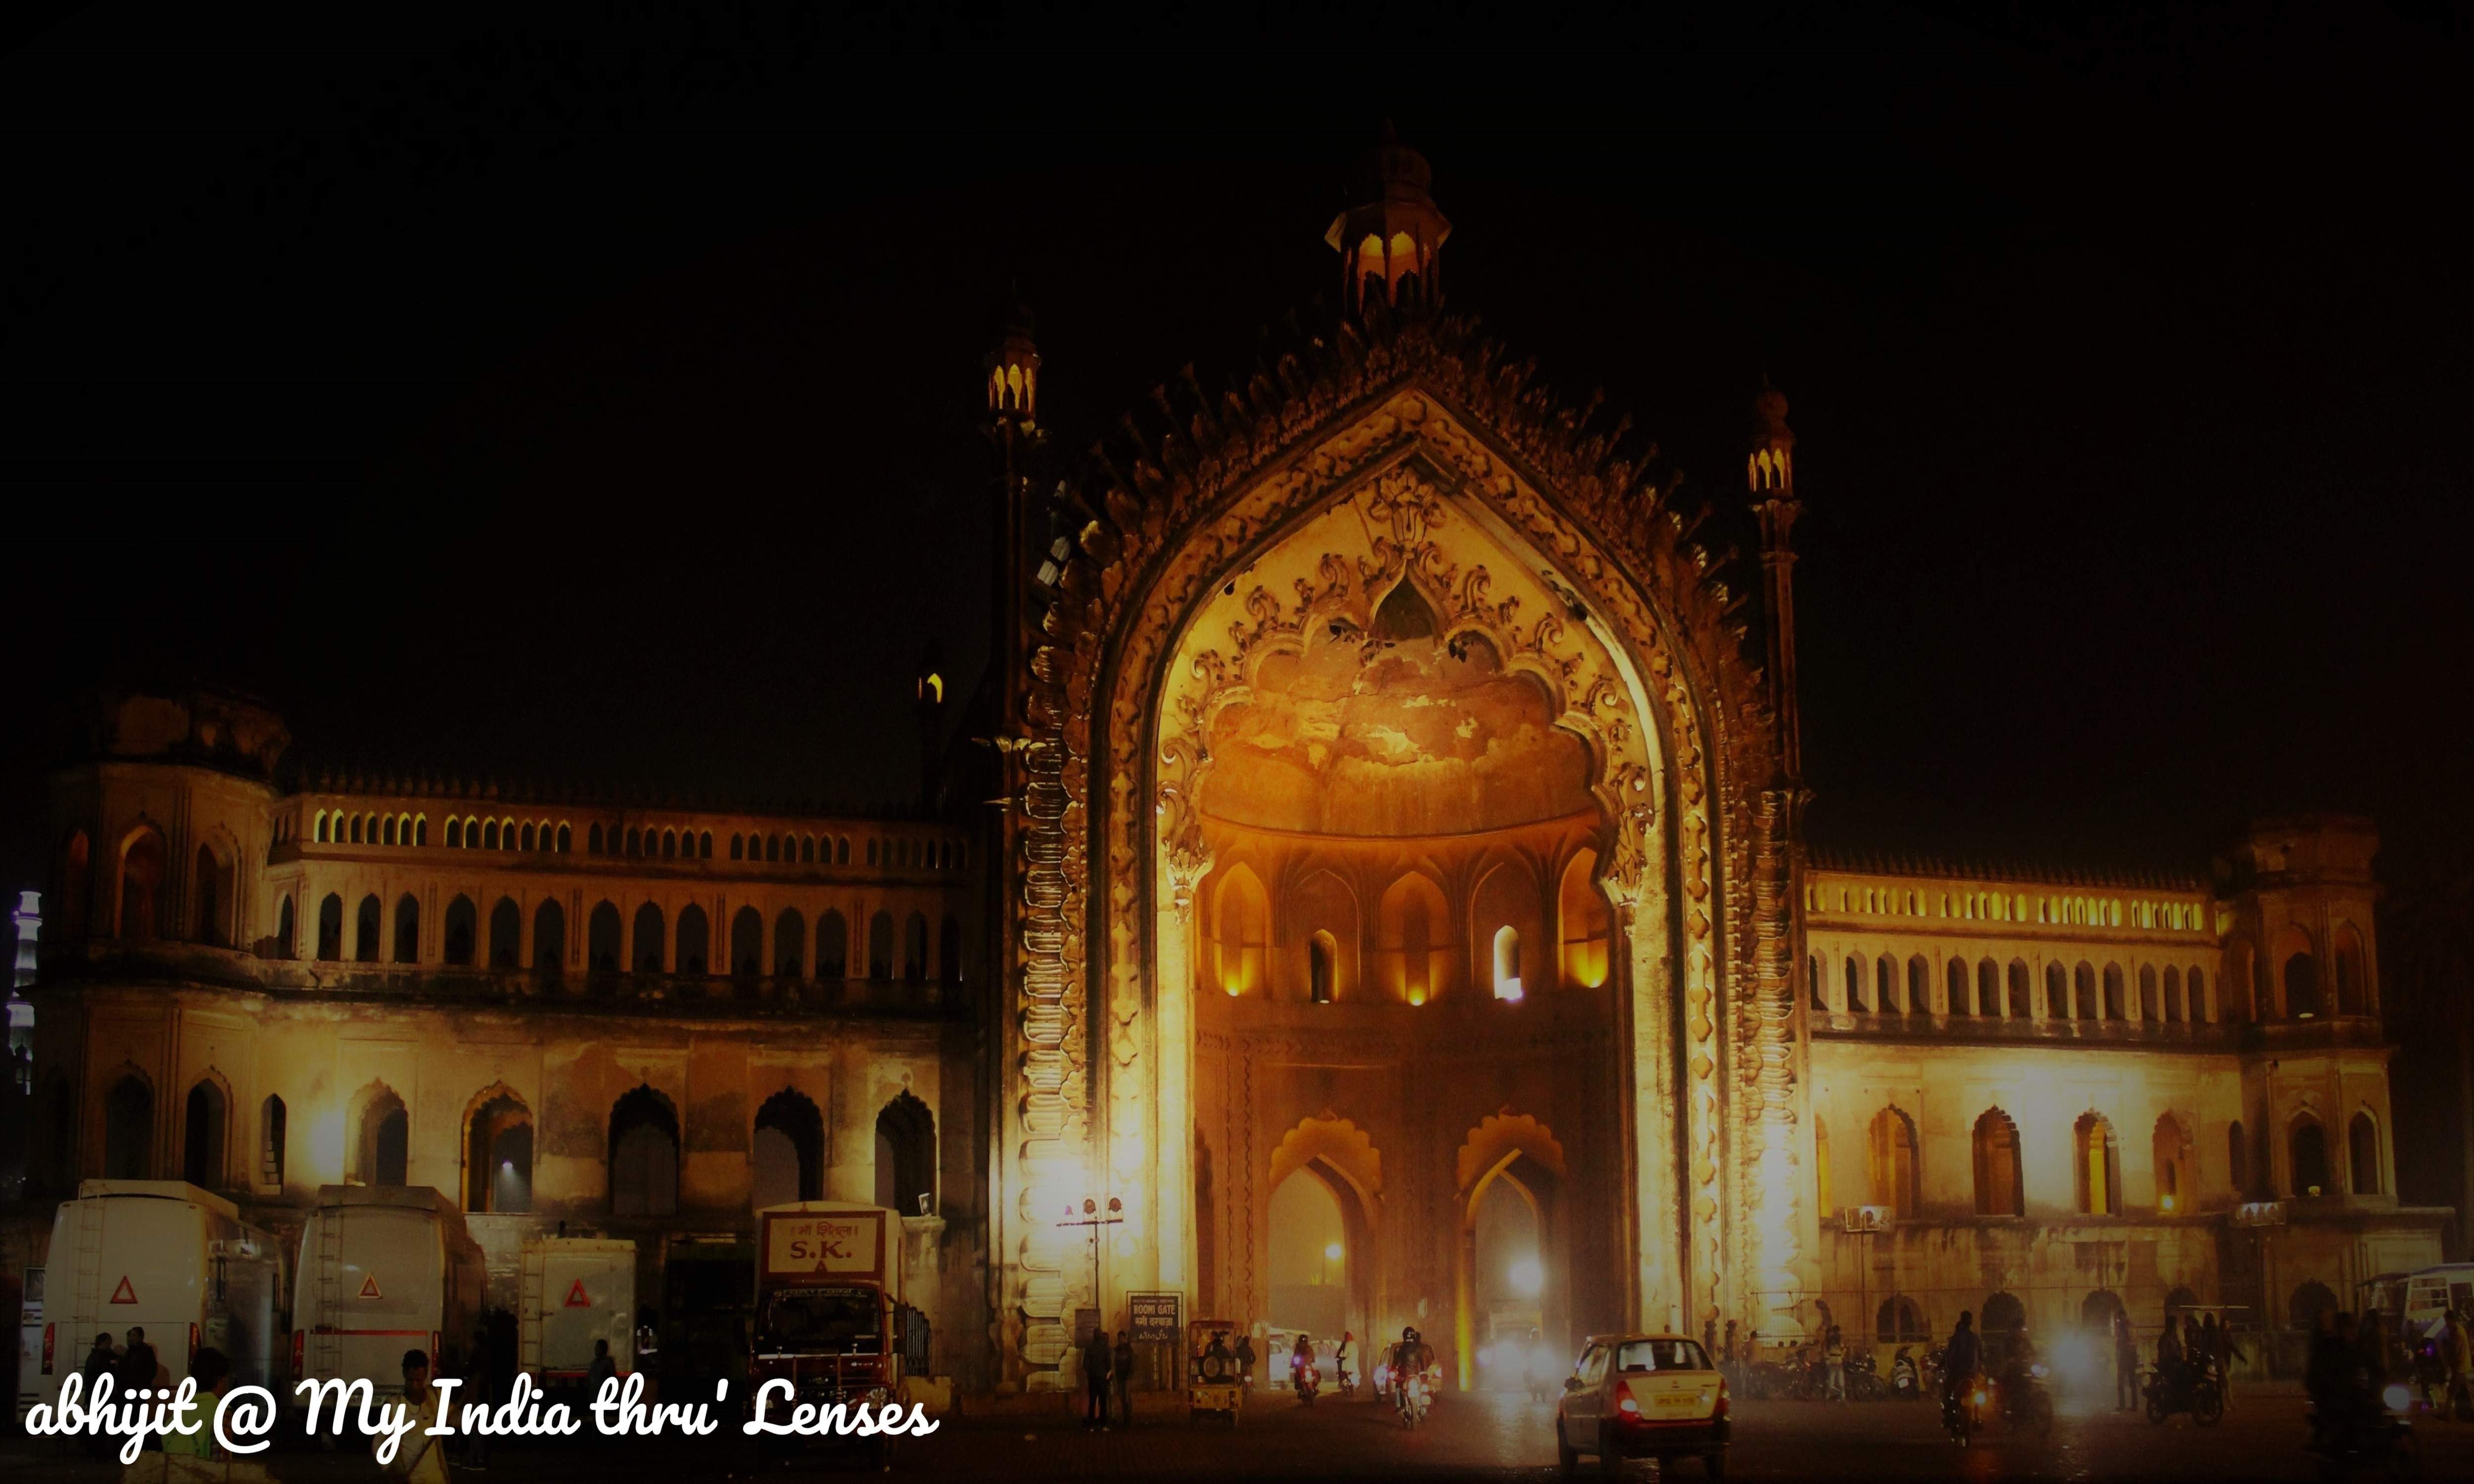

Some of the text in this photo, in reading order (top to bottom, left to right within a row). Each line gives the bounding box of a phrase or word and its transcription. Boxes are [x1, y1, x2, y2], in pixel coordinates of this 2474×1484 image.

[791, 1240, 852, 1258] S.K.
[1134, 1304, 1176, 1315] ROOMI GATE
